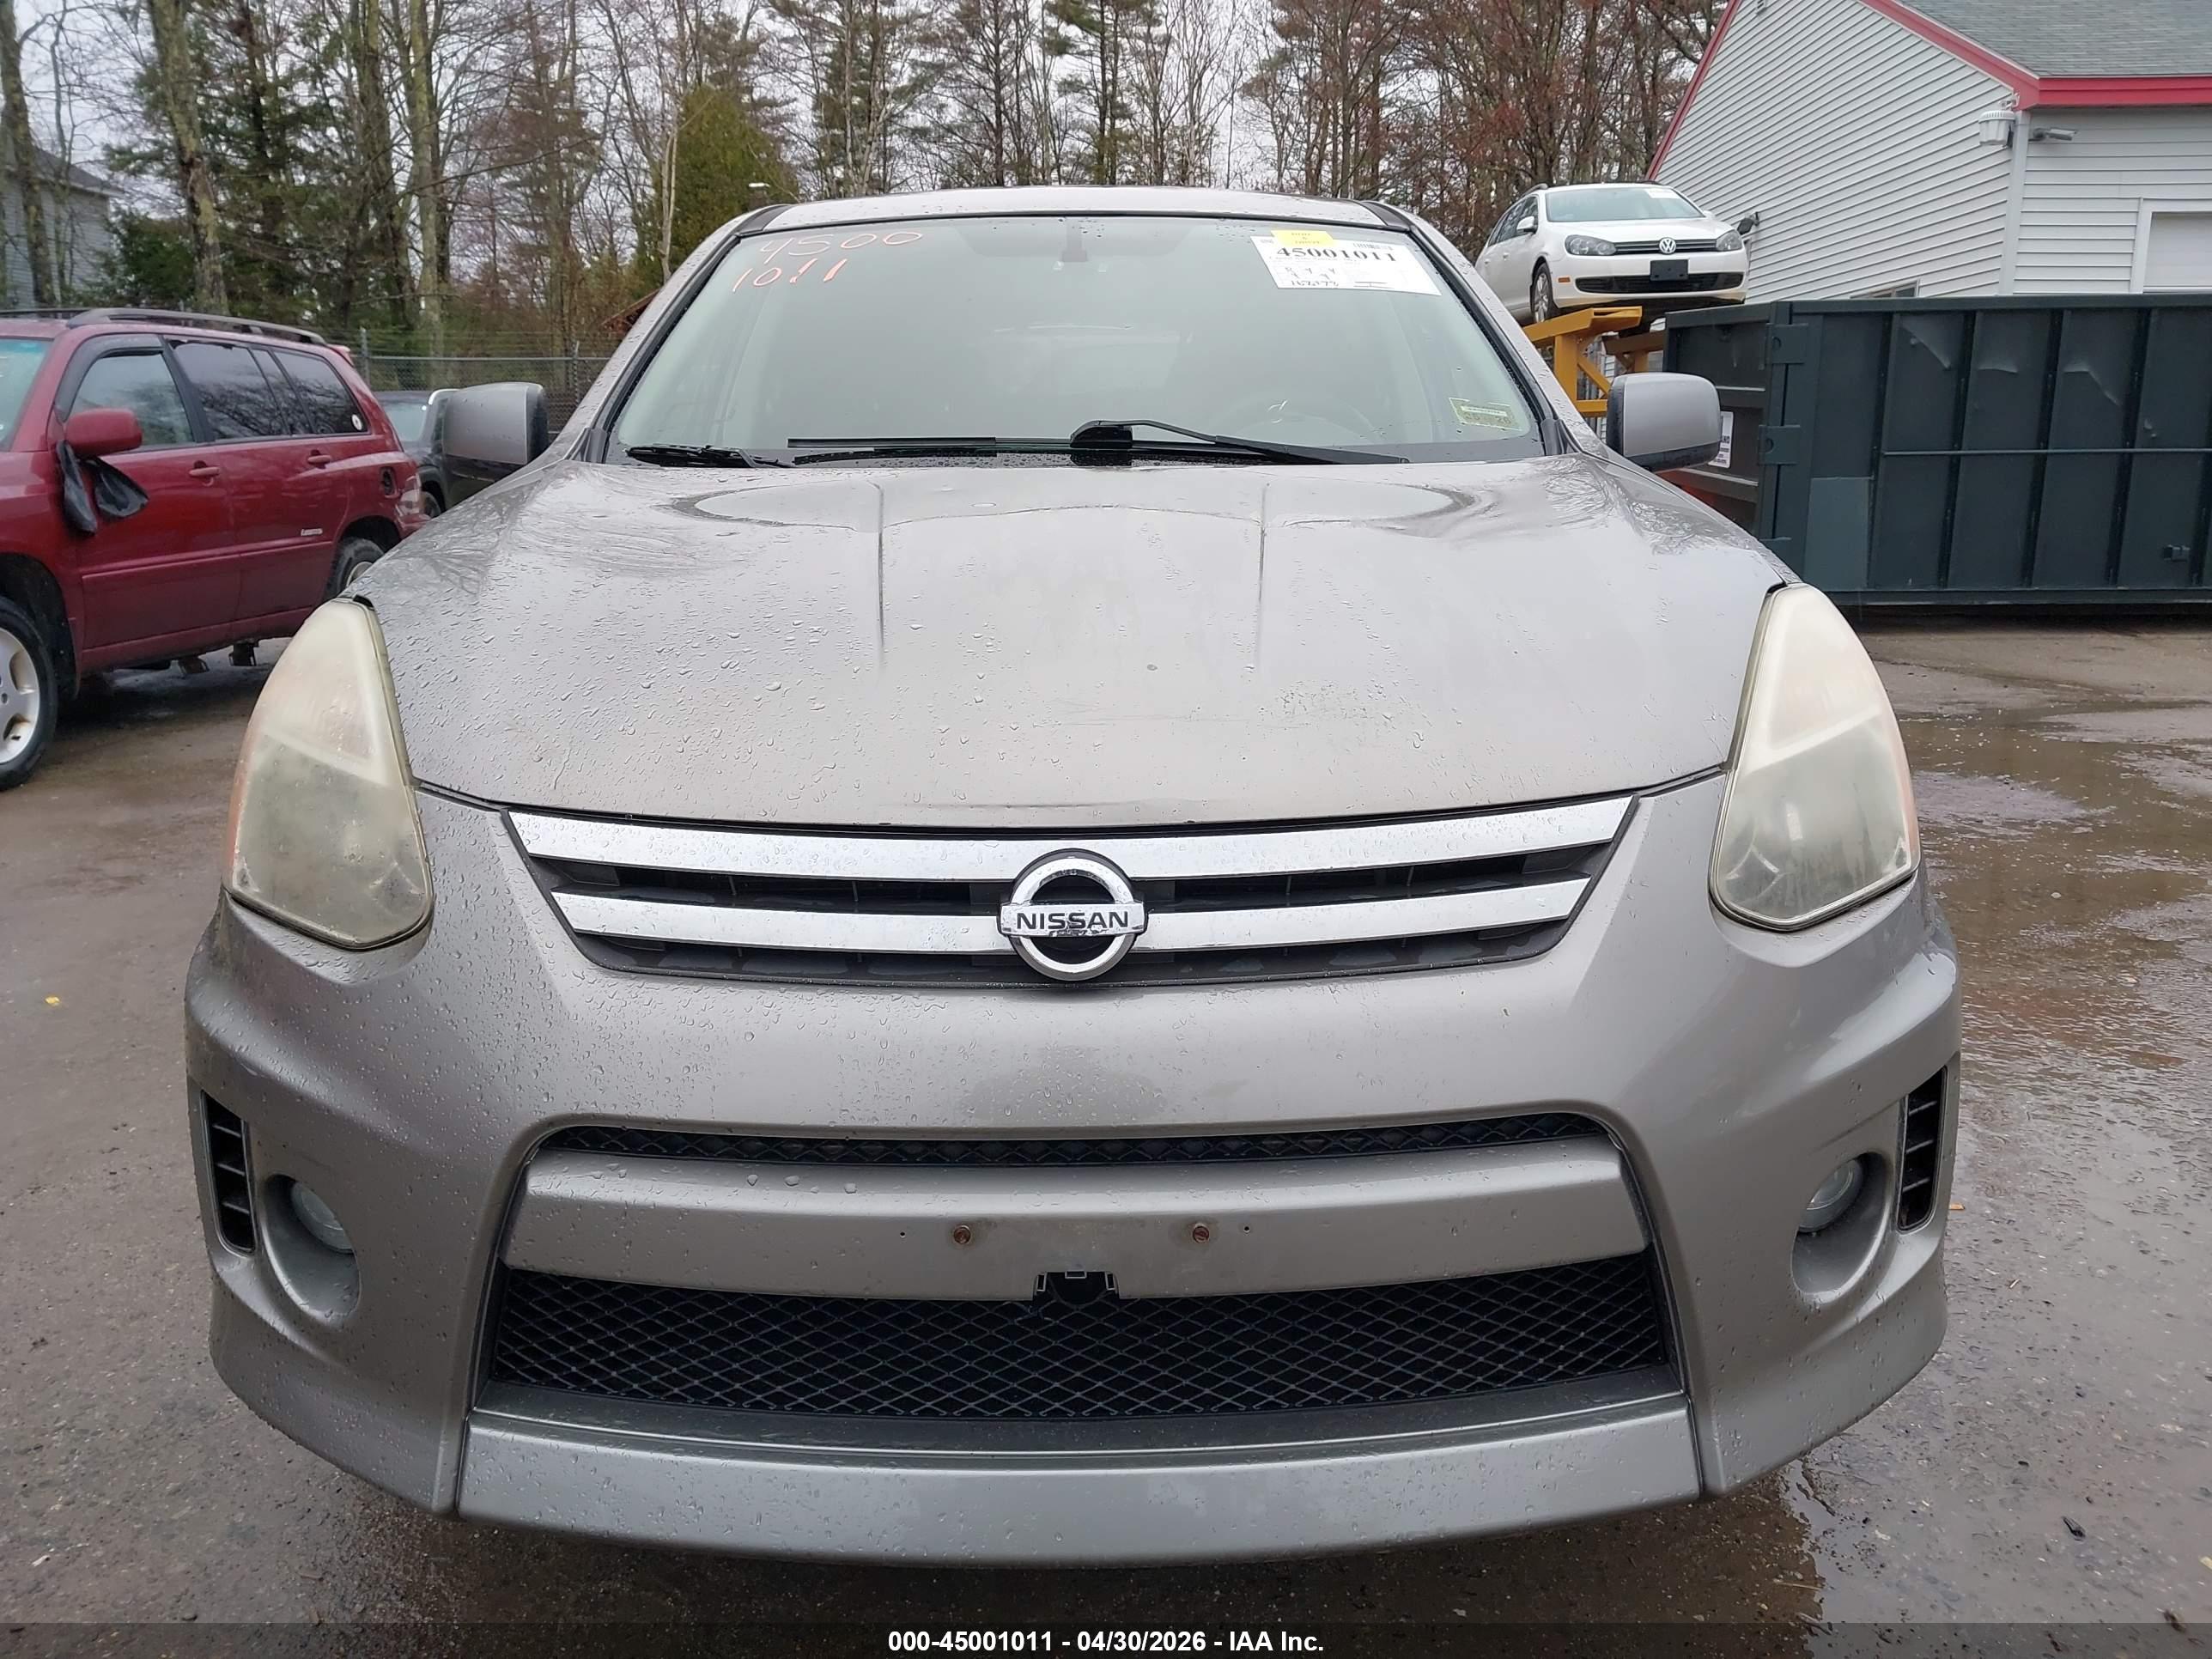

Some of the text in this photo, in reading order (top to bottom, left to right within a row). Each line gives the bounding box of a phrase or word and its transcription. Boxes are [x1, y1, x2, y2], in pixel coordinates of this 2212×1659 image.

[760, 231, 922, 264] 4500
[1277, 246, 1397, 262] 45001011
[1017, 911, 1128, 930] NISSAN
